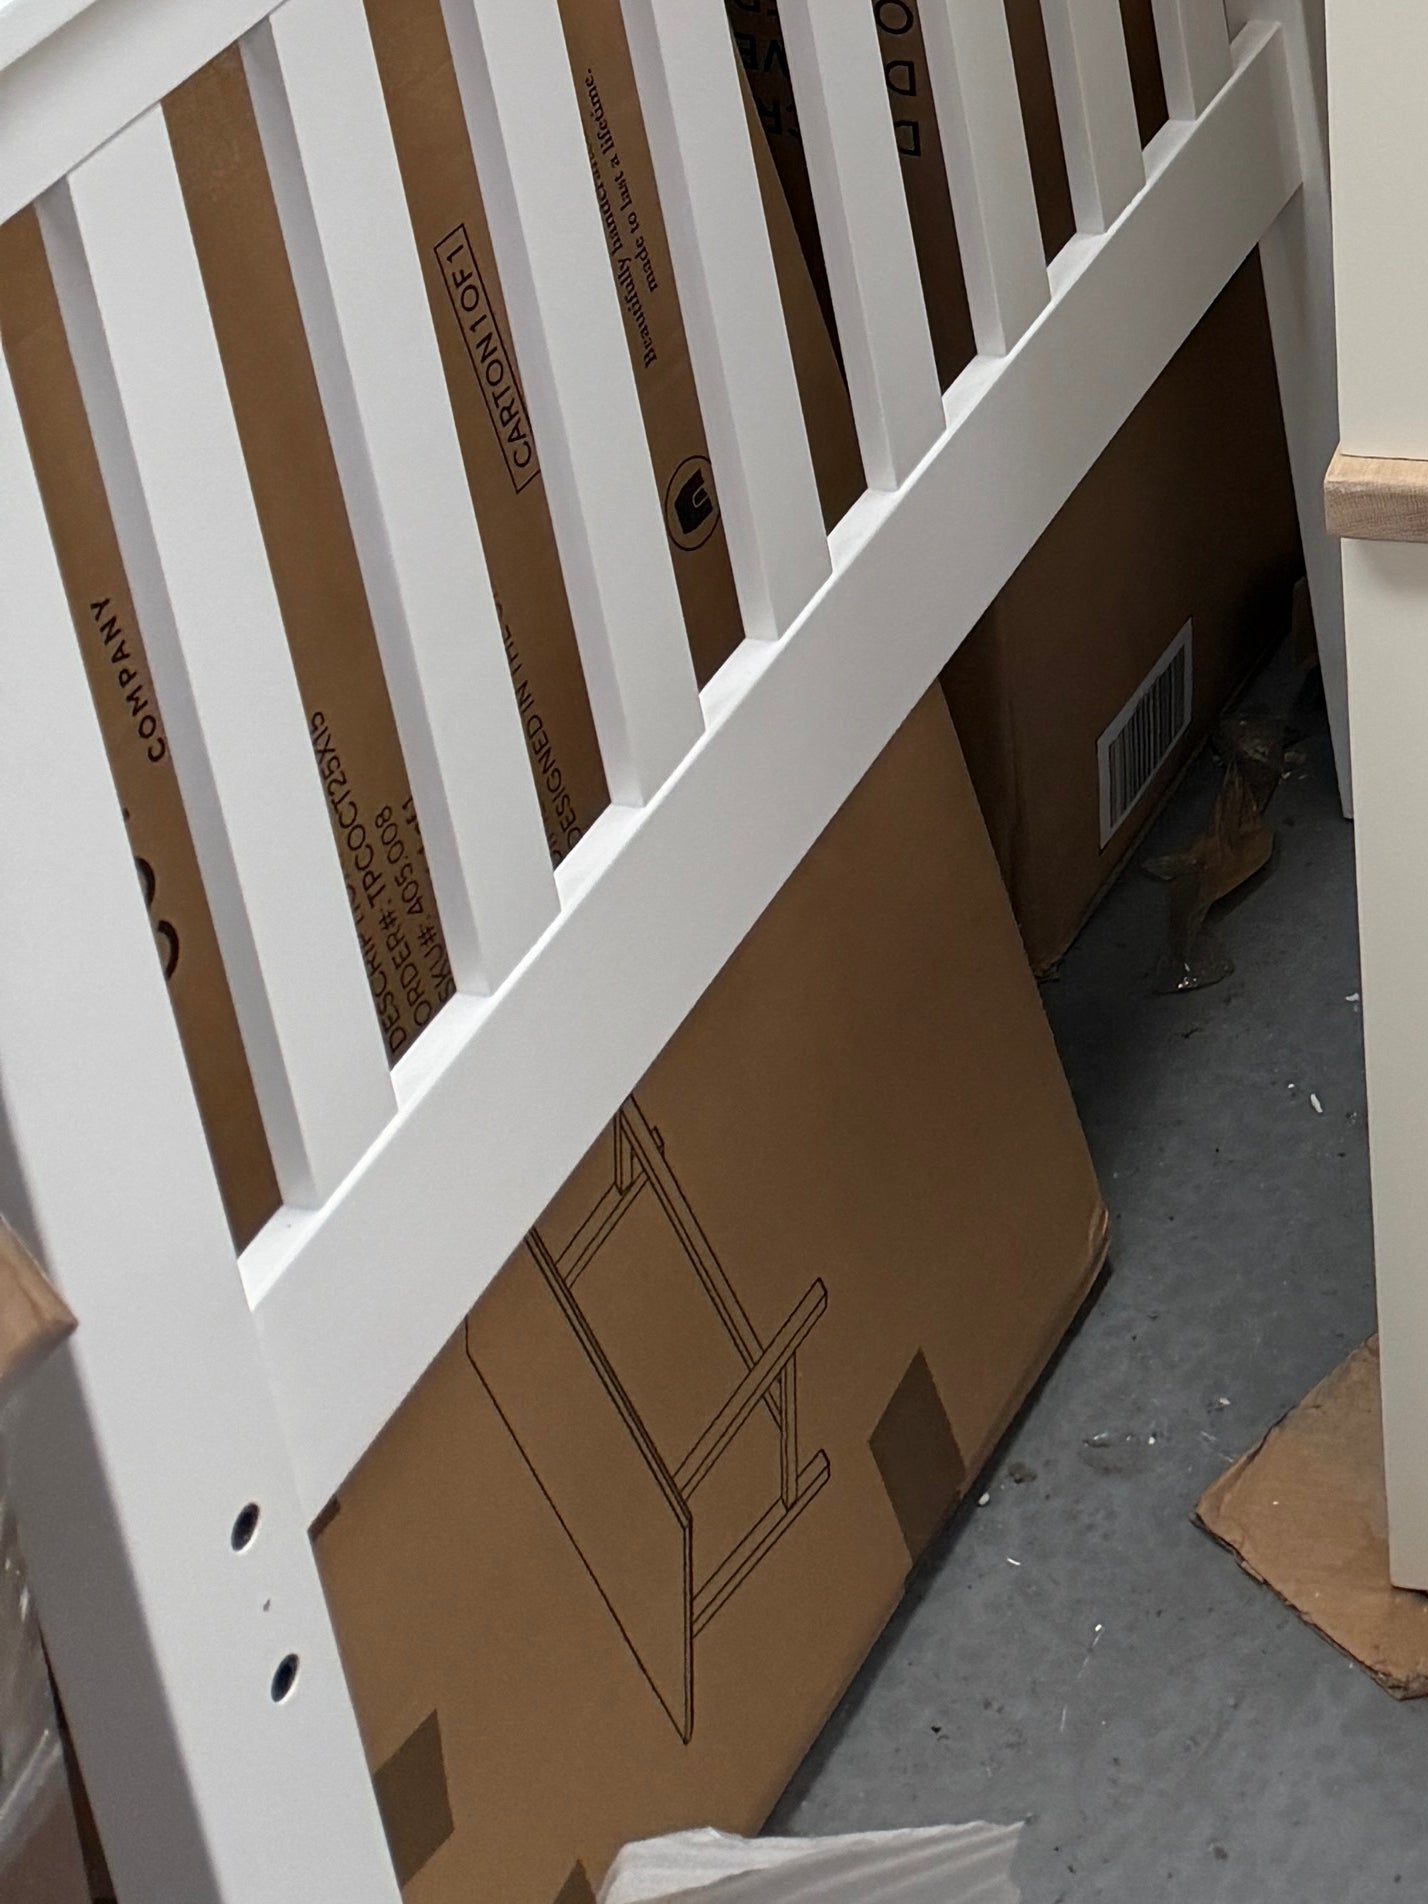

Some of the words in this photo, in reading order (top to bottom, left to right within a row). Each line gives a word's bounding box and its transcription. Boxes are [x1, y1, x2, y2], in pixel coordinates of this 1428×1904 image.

[583, 68, 615, 156] lifetime.
[609, 154, 620, 167] a
[613, 171, 633, 209] last
[446, 245, 463, 263] 1
[627, 212, 641, 233] to
[452, 270, 479, 311] OF
[634, 237, 658, 293] made
[470, 314, 487, 333] 1
[614, 258, 658, 369] Beautifully
[475, 331, 531, 468] CARTON
[90, 597, 165, 763] COMPANY
[526, 713, 582, 850] DESIGNED
[375, 804, 424, 914] 405.008
[379, 898, 434, 1028] ORDER#:
